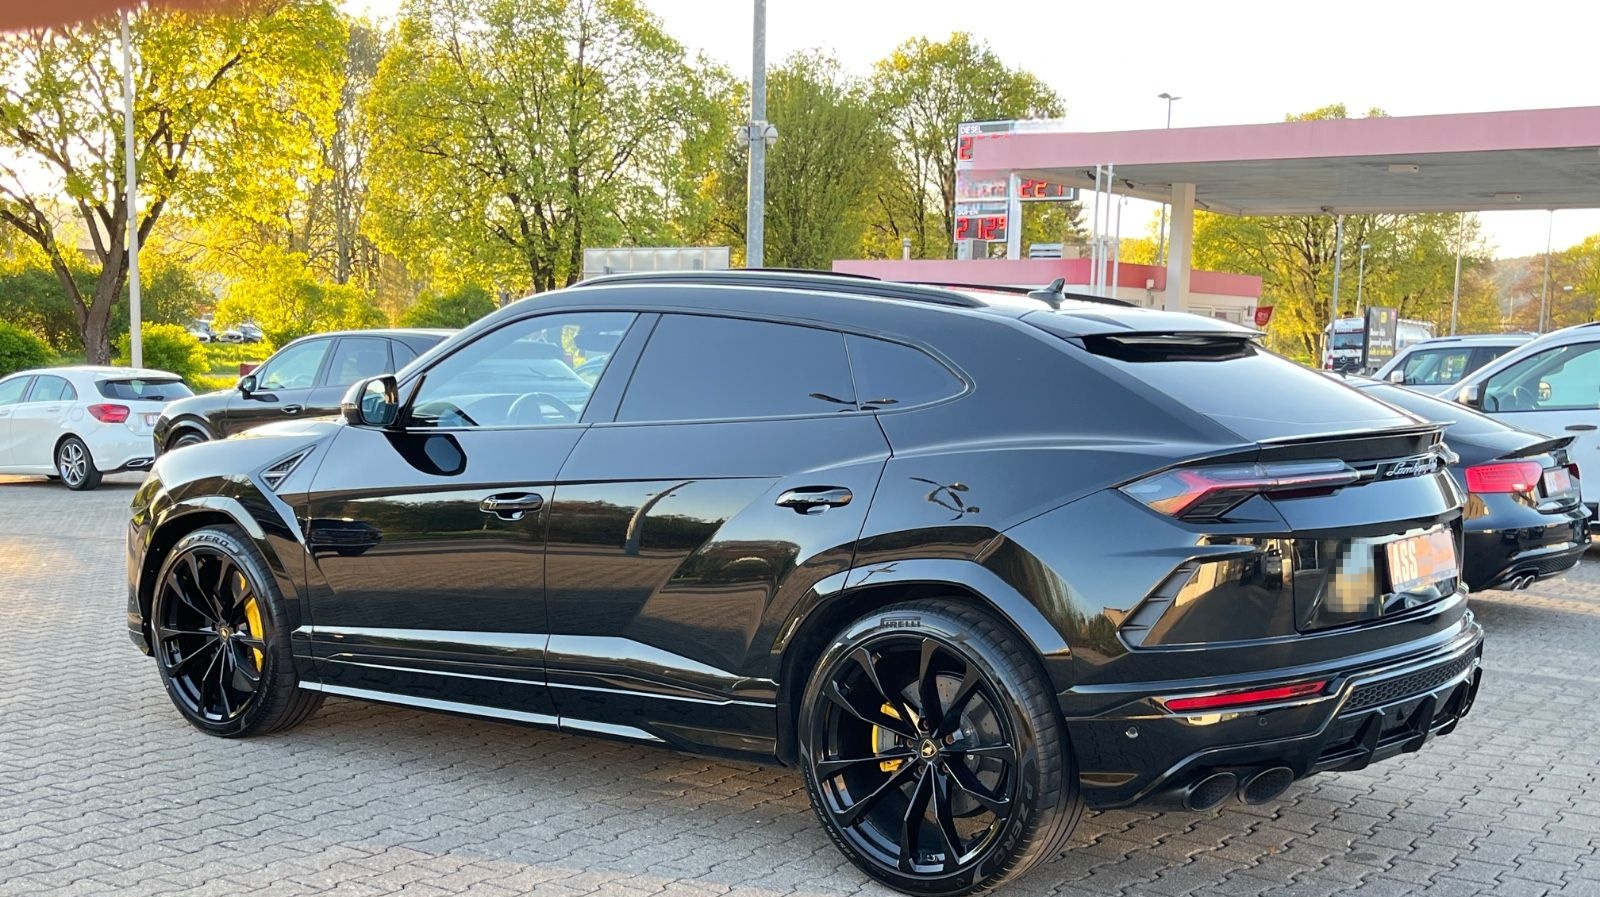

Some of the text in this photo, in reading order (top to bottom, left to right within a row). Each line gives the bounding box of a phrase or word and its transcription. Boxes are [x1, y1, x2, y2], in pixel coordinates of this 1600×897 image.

[960, 126, 982, 134] DIESEL
[197, 535, 230, 547] ZERO
[880, 616, 922, 628] PIRELLI
